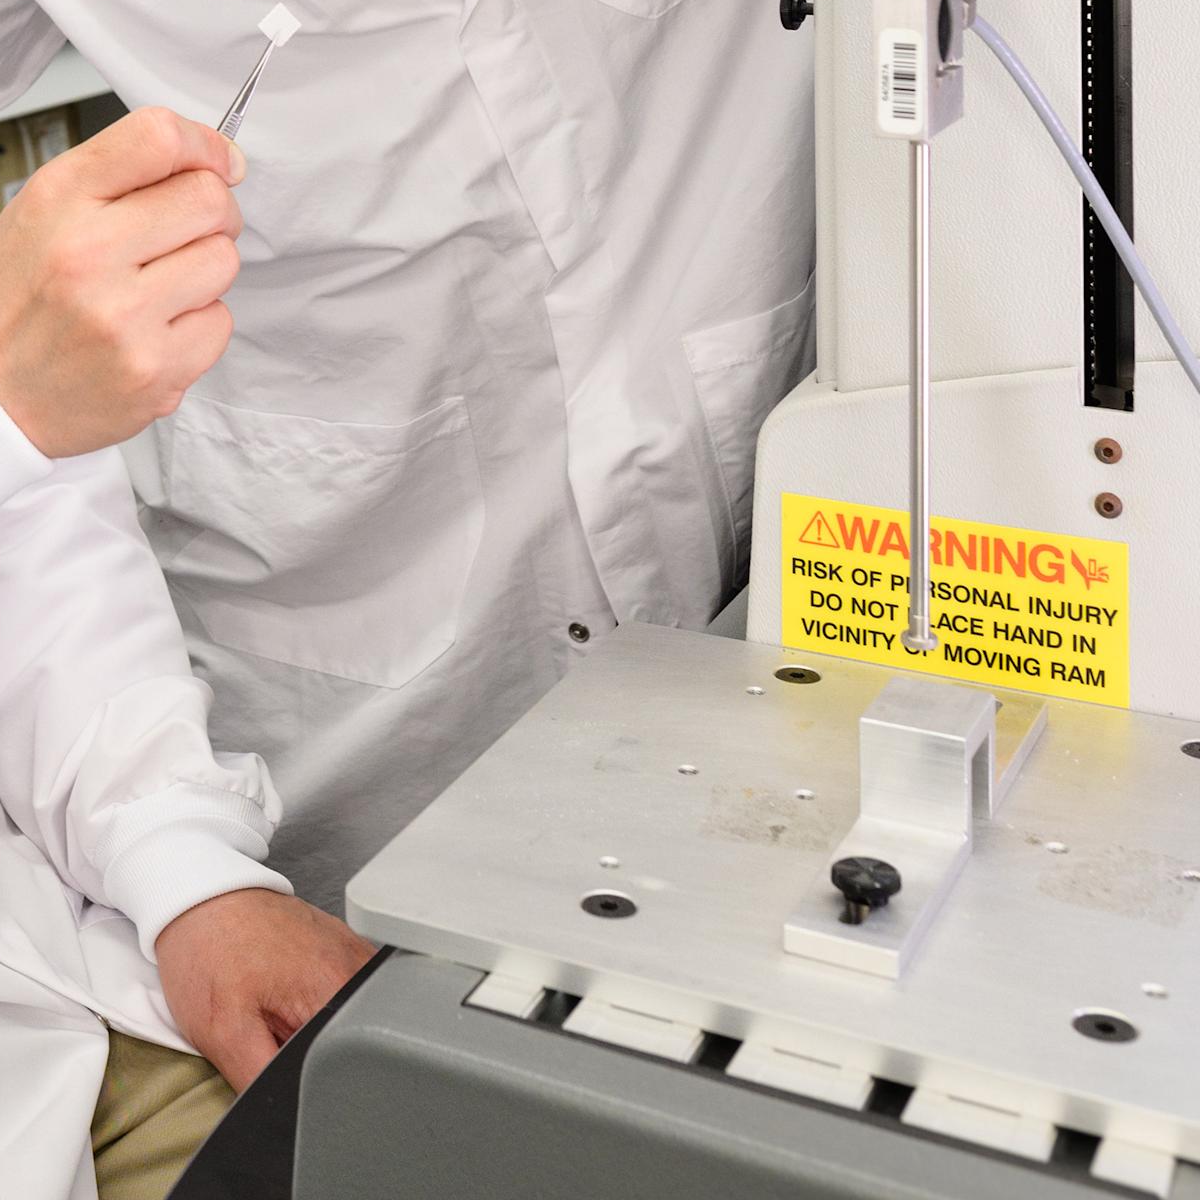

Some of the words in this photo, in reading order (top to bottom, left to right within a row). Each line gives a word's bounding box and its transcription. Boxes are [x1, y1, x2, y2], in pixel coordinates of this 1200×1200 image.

[792, 557, 844, 583] RISK
[851, 568, 882, 588] OF
[891, 574, 1020, 612] PSONAL
[1028, 596, 1118, 627] INJURY
[810, 590, 843, 612] DO
[851, 597, 899, 621] NOT
[908, 606, 984, 637] ACE
[993, 621, 1062, 649] HAND
[1072, 634, 1096, 655] IN
[801, 618, 896, 650] VICINITY
[944, 643, 1041, 677] MOVING
[1050, 661, 1106, 688] RAM
